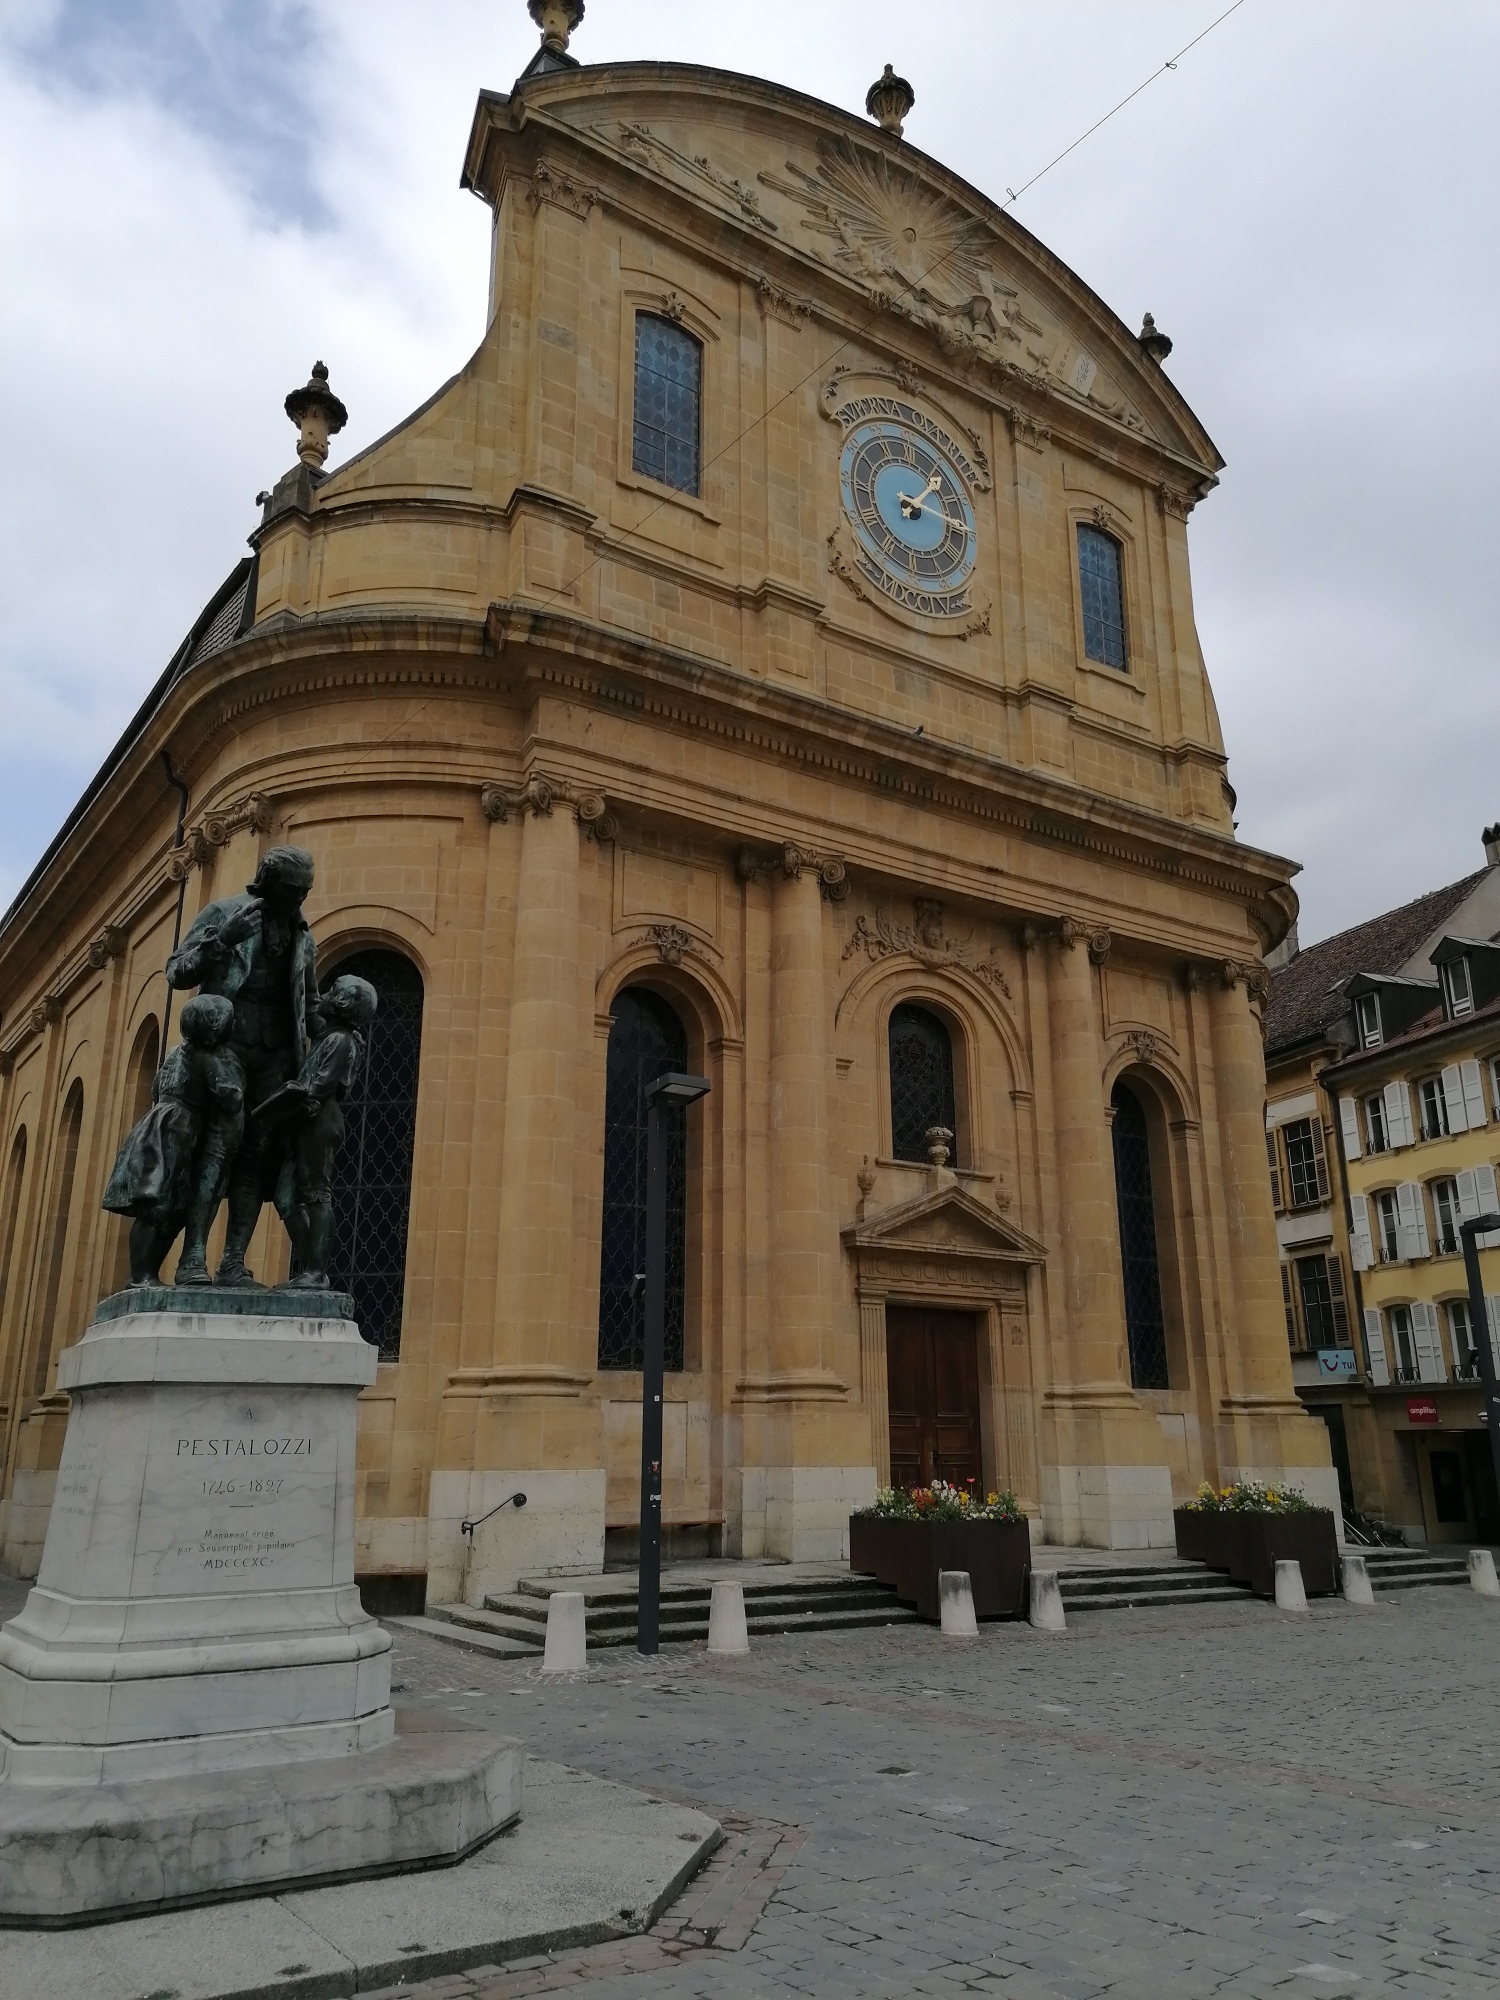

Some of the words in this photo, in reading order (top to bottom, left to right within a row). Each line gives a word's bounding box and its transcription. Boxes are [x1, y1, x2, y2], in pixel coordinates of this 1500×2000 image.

[837, 397, 903, 427] SVPERNA
[903, 444, 916, 464] XII
[879, 573, 949, 615] MDCCLV
[1342, 1361, 1355, 1369] TUI
[1409, 1406, 1437, 1416] amplifon
[176, 1438, 312, 1456] PESTALOZZI
[203, 1529, 248, 1540] Monument
